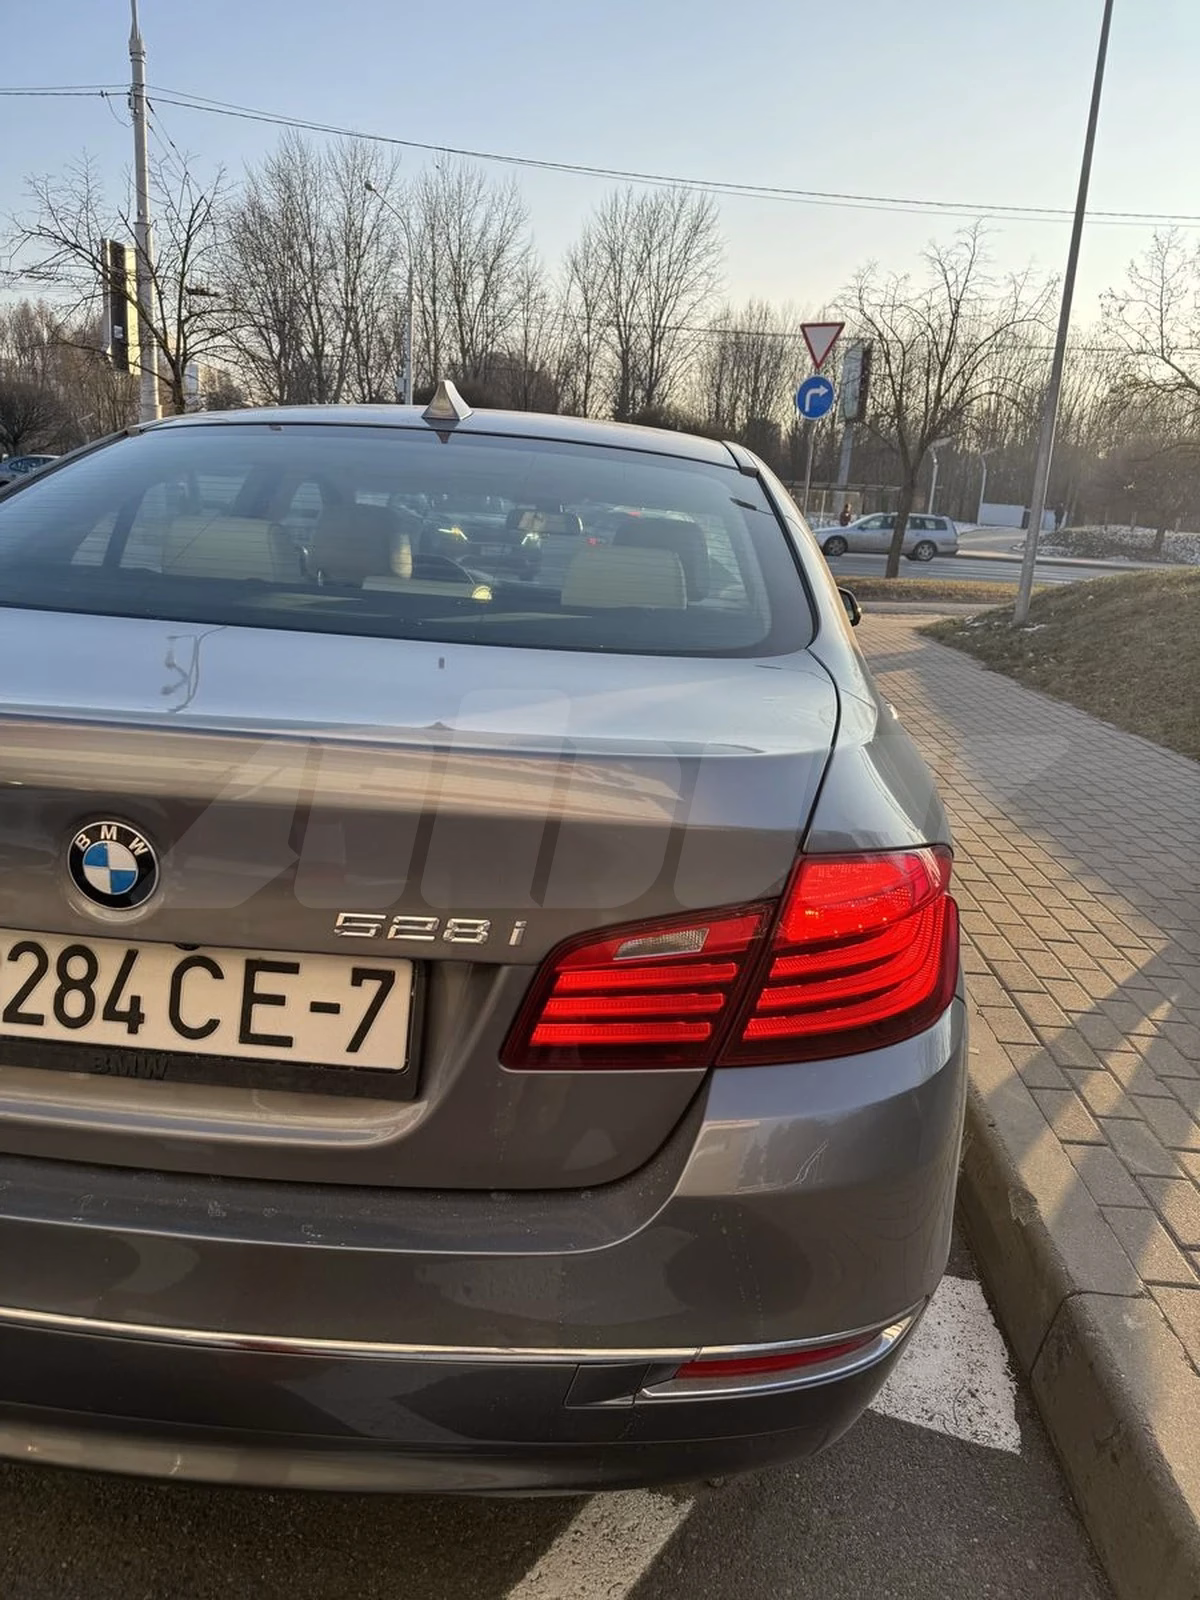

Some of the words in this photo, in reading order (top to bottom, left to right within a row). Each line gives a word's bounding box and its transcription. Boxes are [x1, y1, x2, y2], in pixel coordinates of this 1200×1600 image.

[75, 825, 149, 856] BMW
[169, 955, 396, 1053] CE-7
[94, 1052, 168, 1080] BMW
